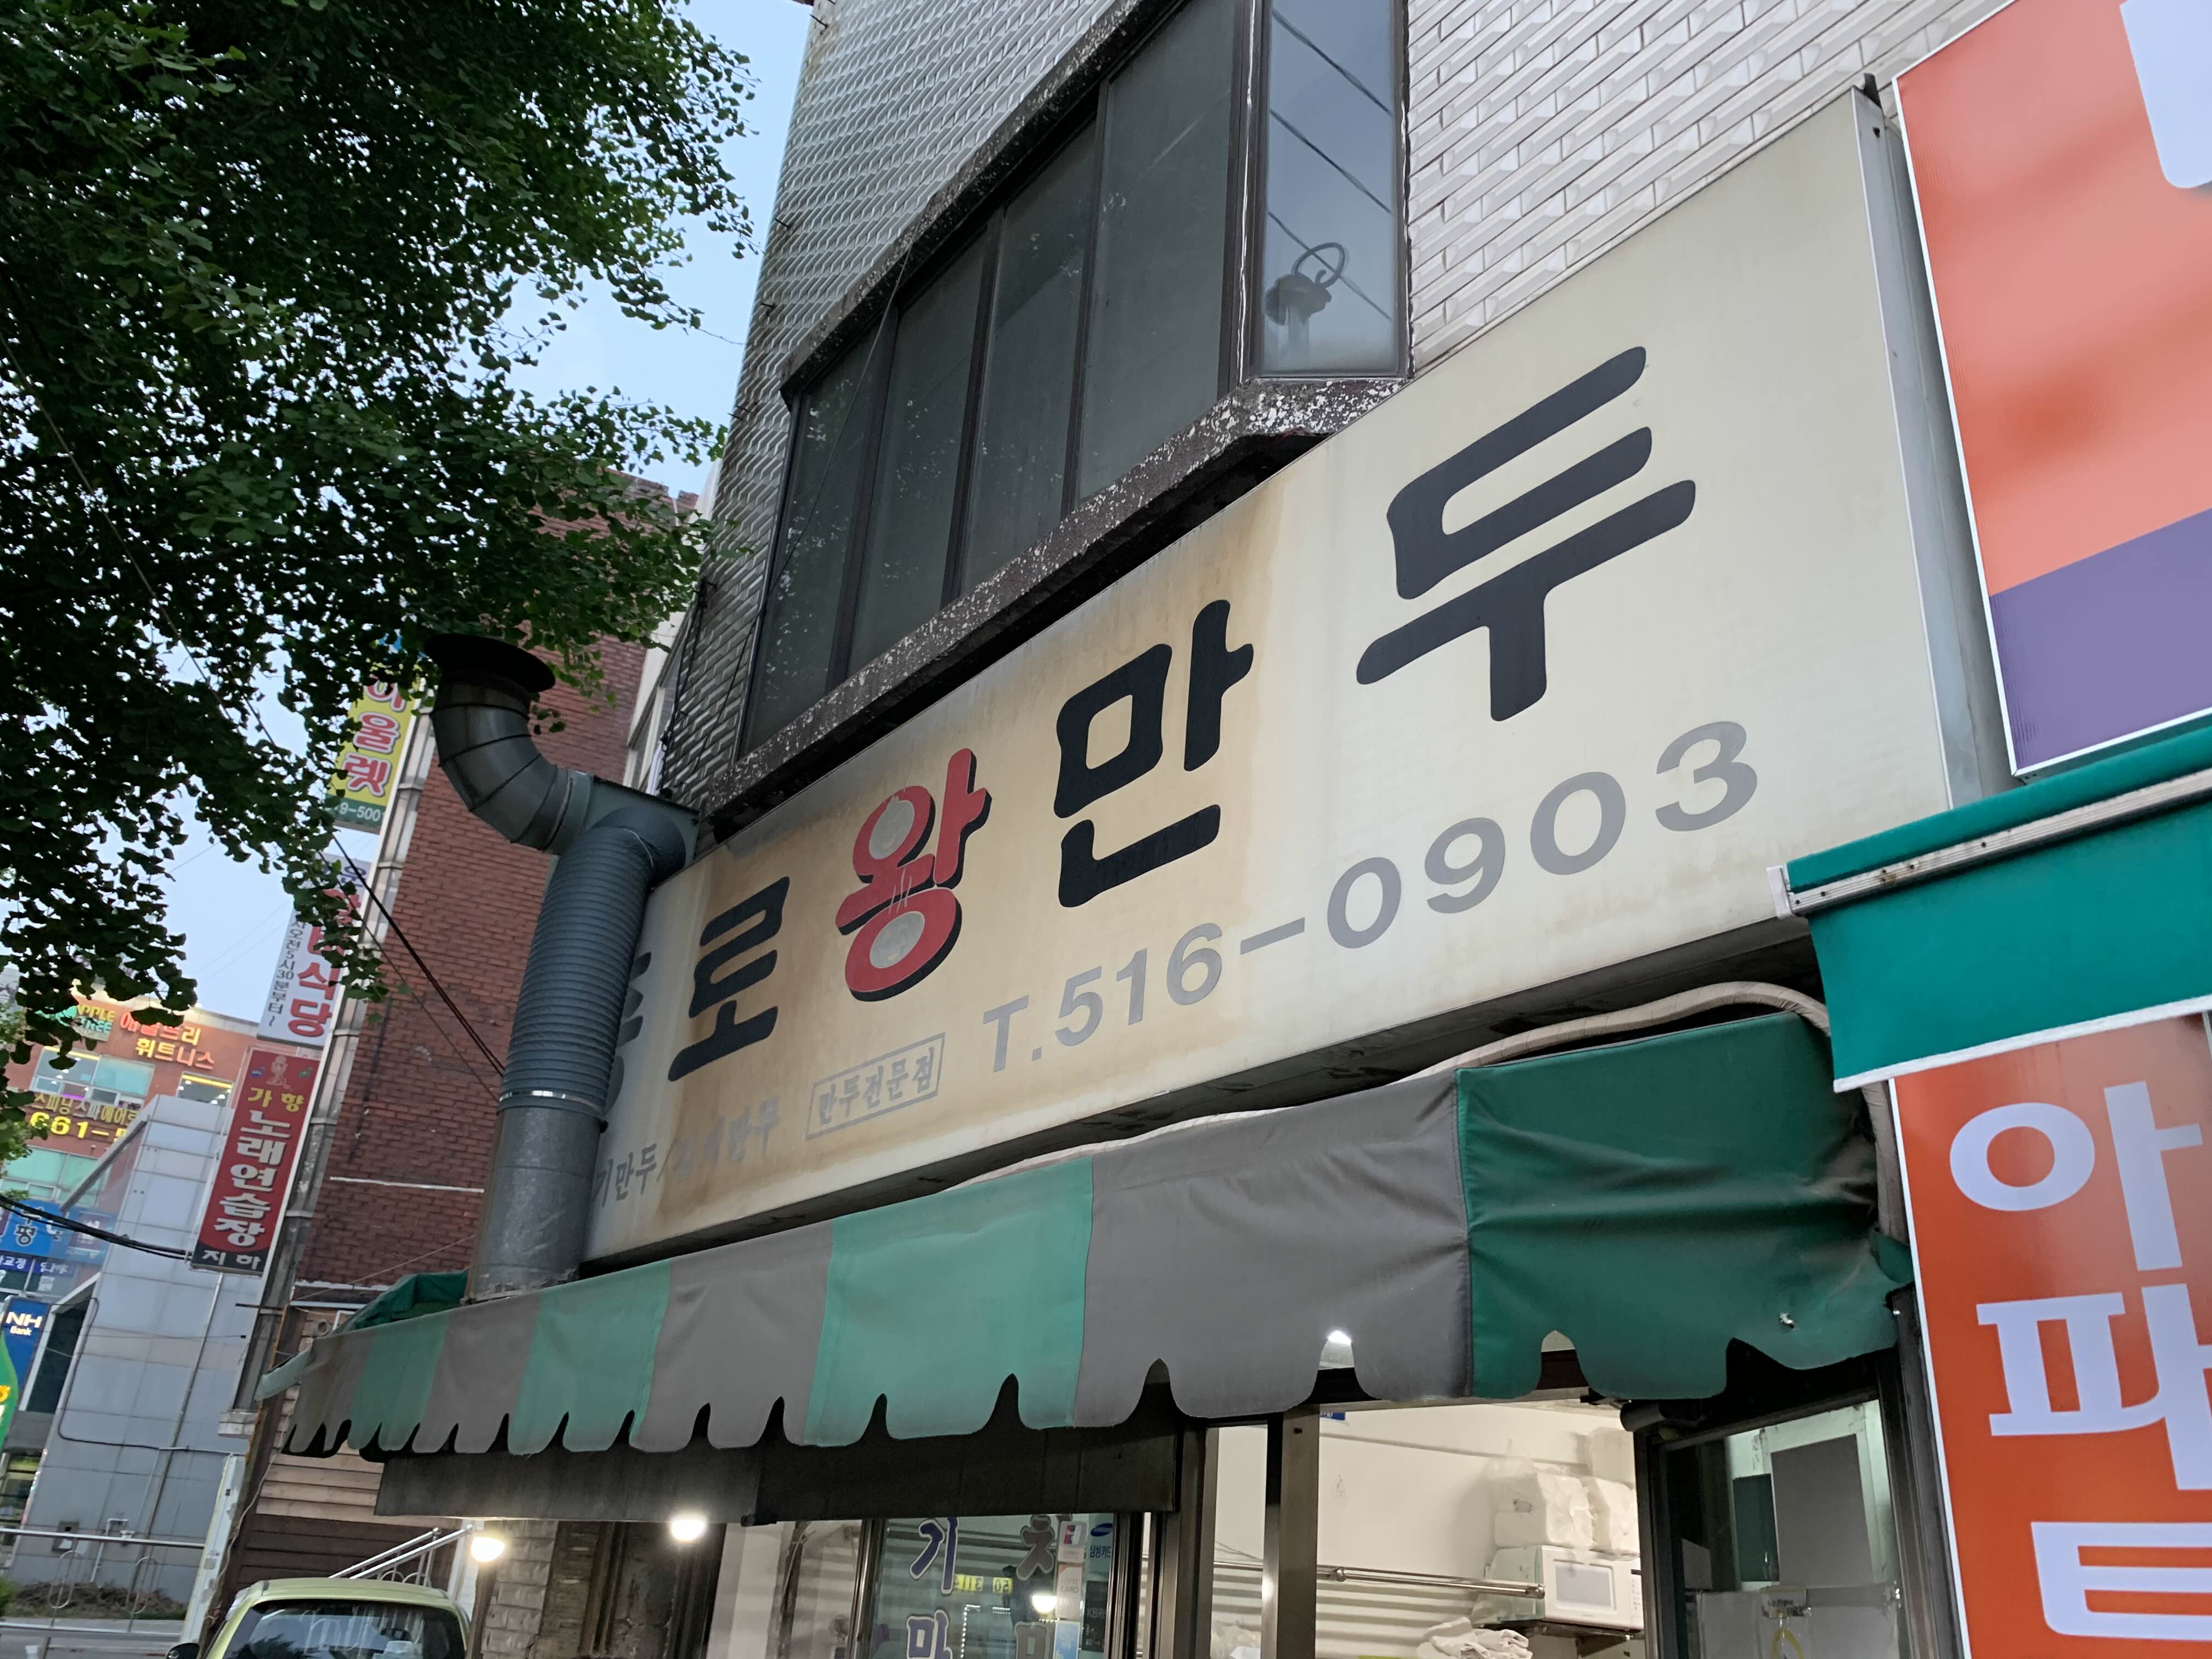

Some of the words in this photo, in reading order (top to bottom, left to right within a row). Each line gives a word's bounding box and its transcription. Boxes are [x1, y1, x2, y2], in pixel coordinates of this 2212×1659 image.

[984, 721, 1758, 1073] T.516-0903
[135, 1037, 215, 1069] 휘트니스
[819, 1047, 934, 1125] 만두전문점
[213, 1110, 291, 1246] 노래연습장
[202, 1250, 261, 1270] 지하
[5, 1311, 42, 1328] NH
[10, 1326, 32, 1336] Bank
